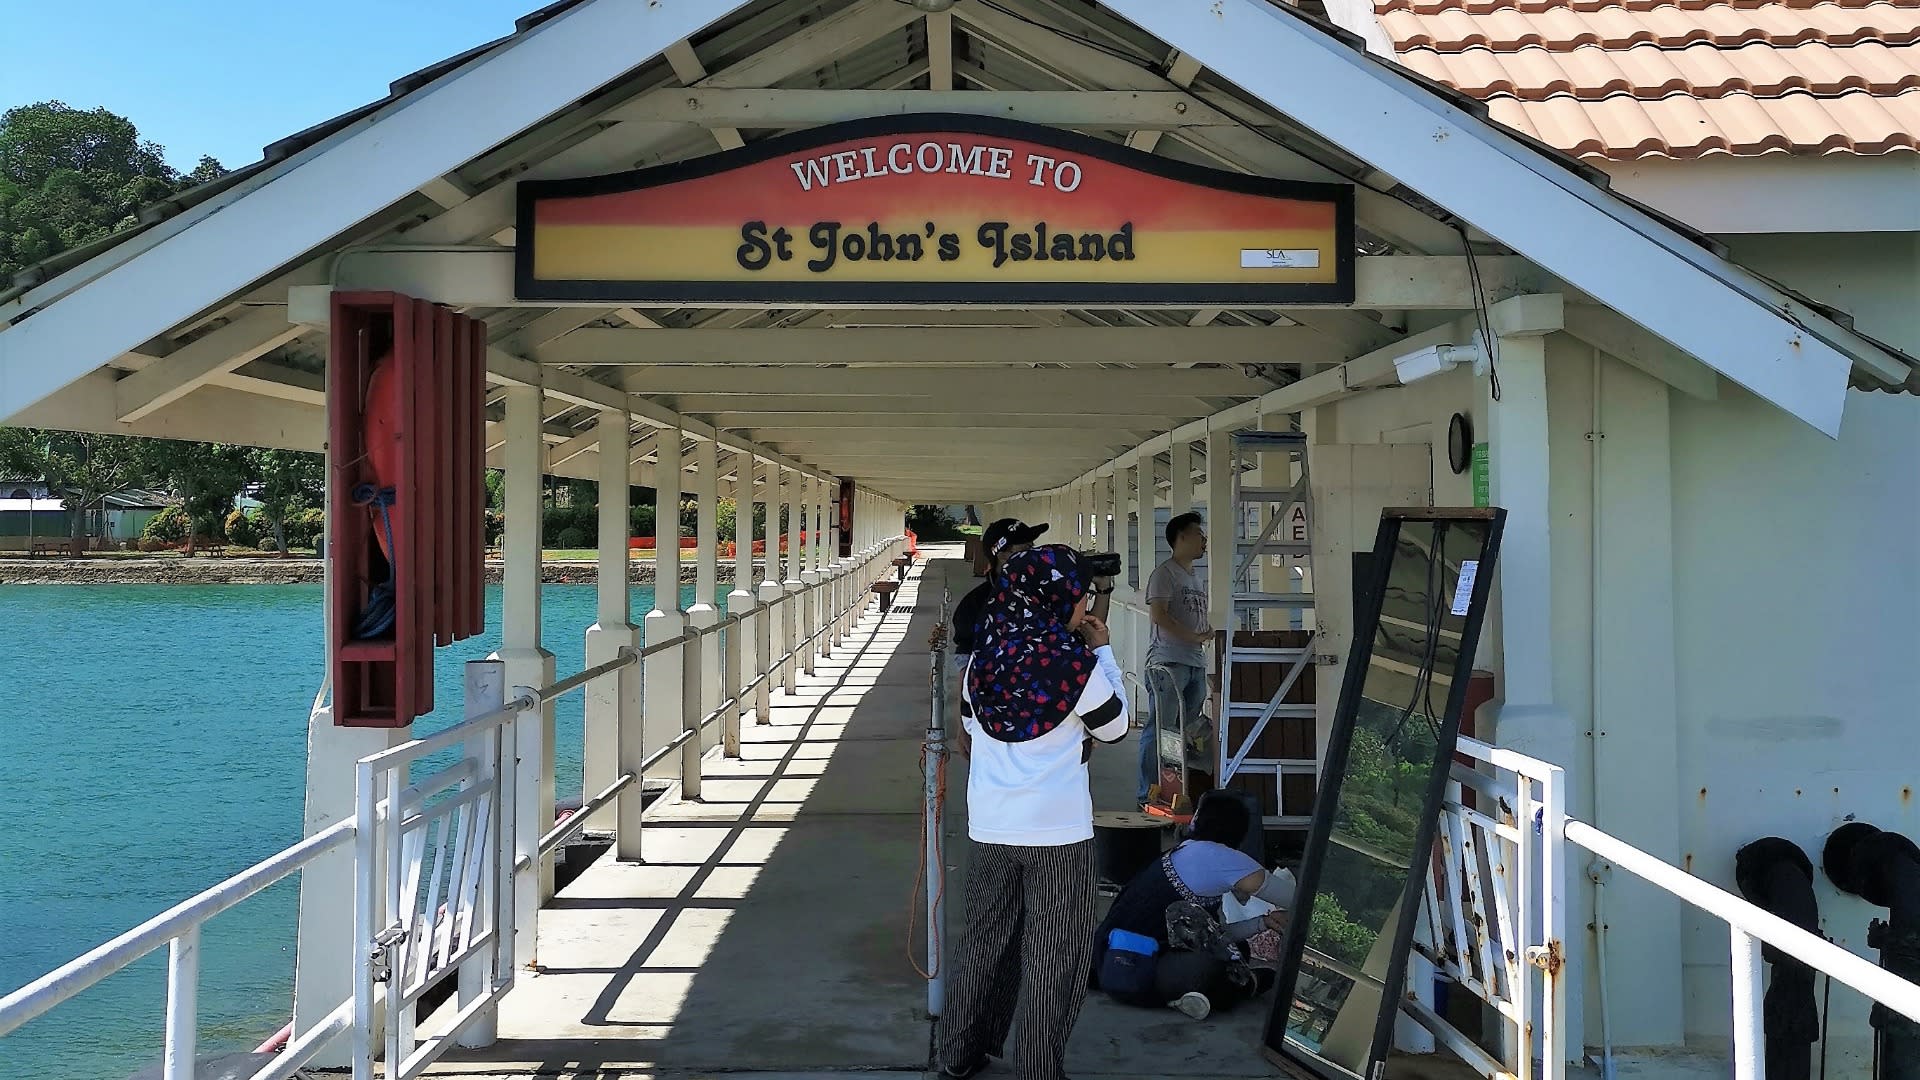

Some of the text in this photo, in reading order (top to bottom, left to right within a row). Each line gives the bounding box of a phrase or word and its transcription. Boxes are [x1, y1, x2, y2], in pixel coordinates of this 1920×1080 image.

[790, 142, 1082, 192] WELCOME TO
[737, 220, 1136, 272] St John's Island
[1266, 249, 1286, 259] SLA
[1291, 506, 1306, 559] AE
